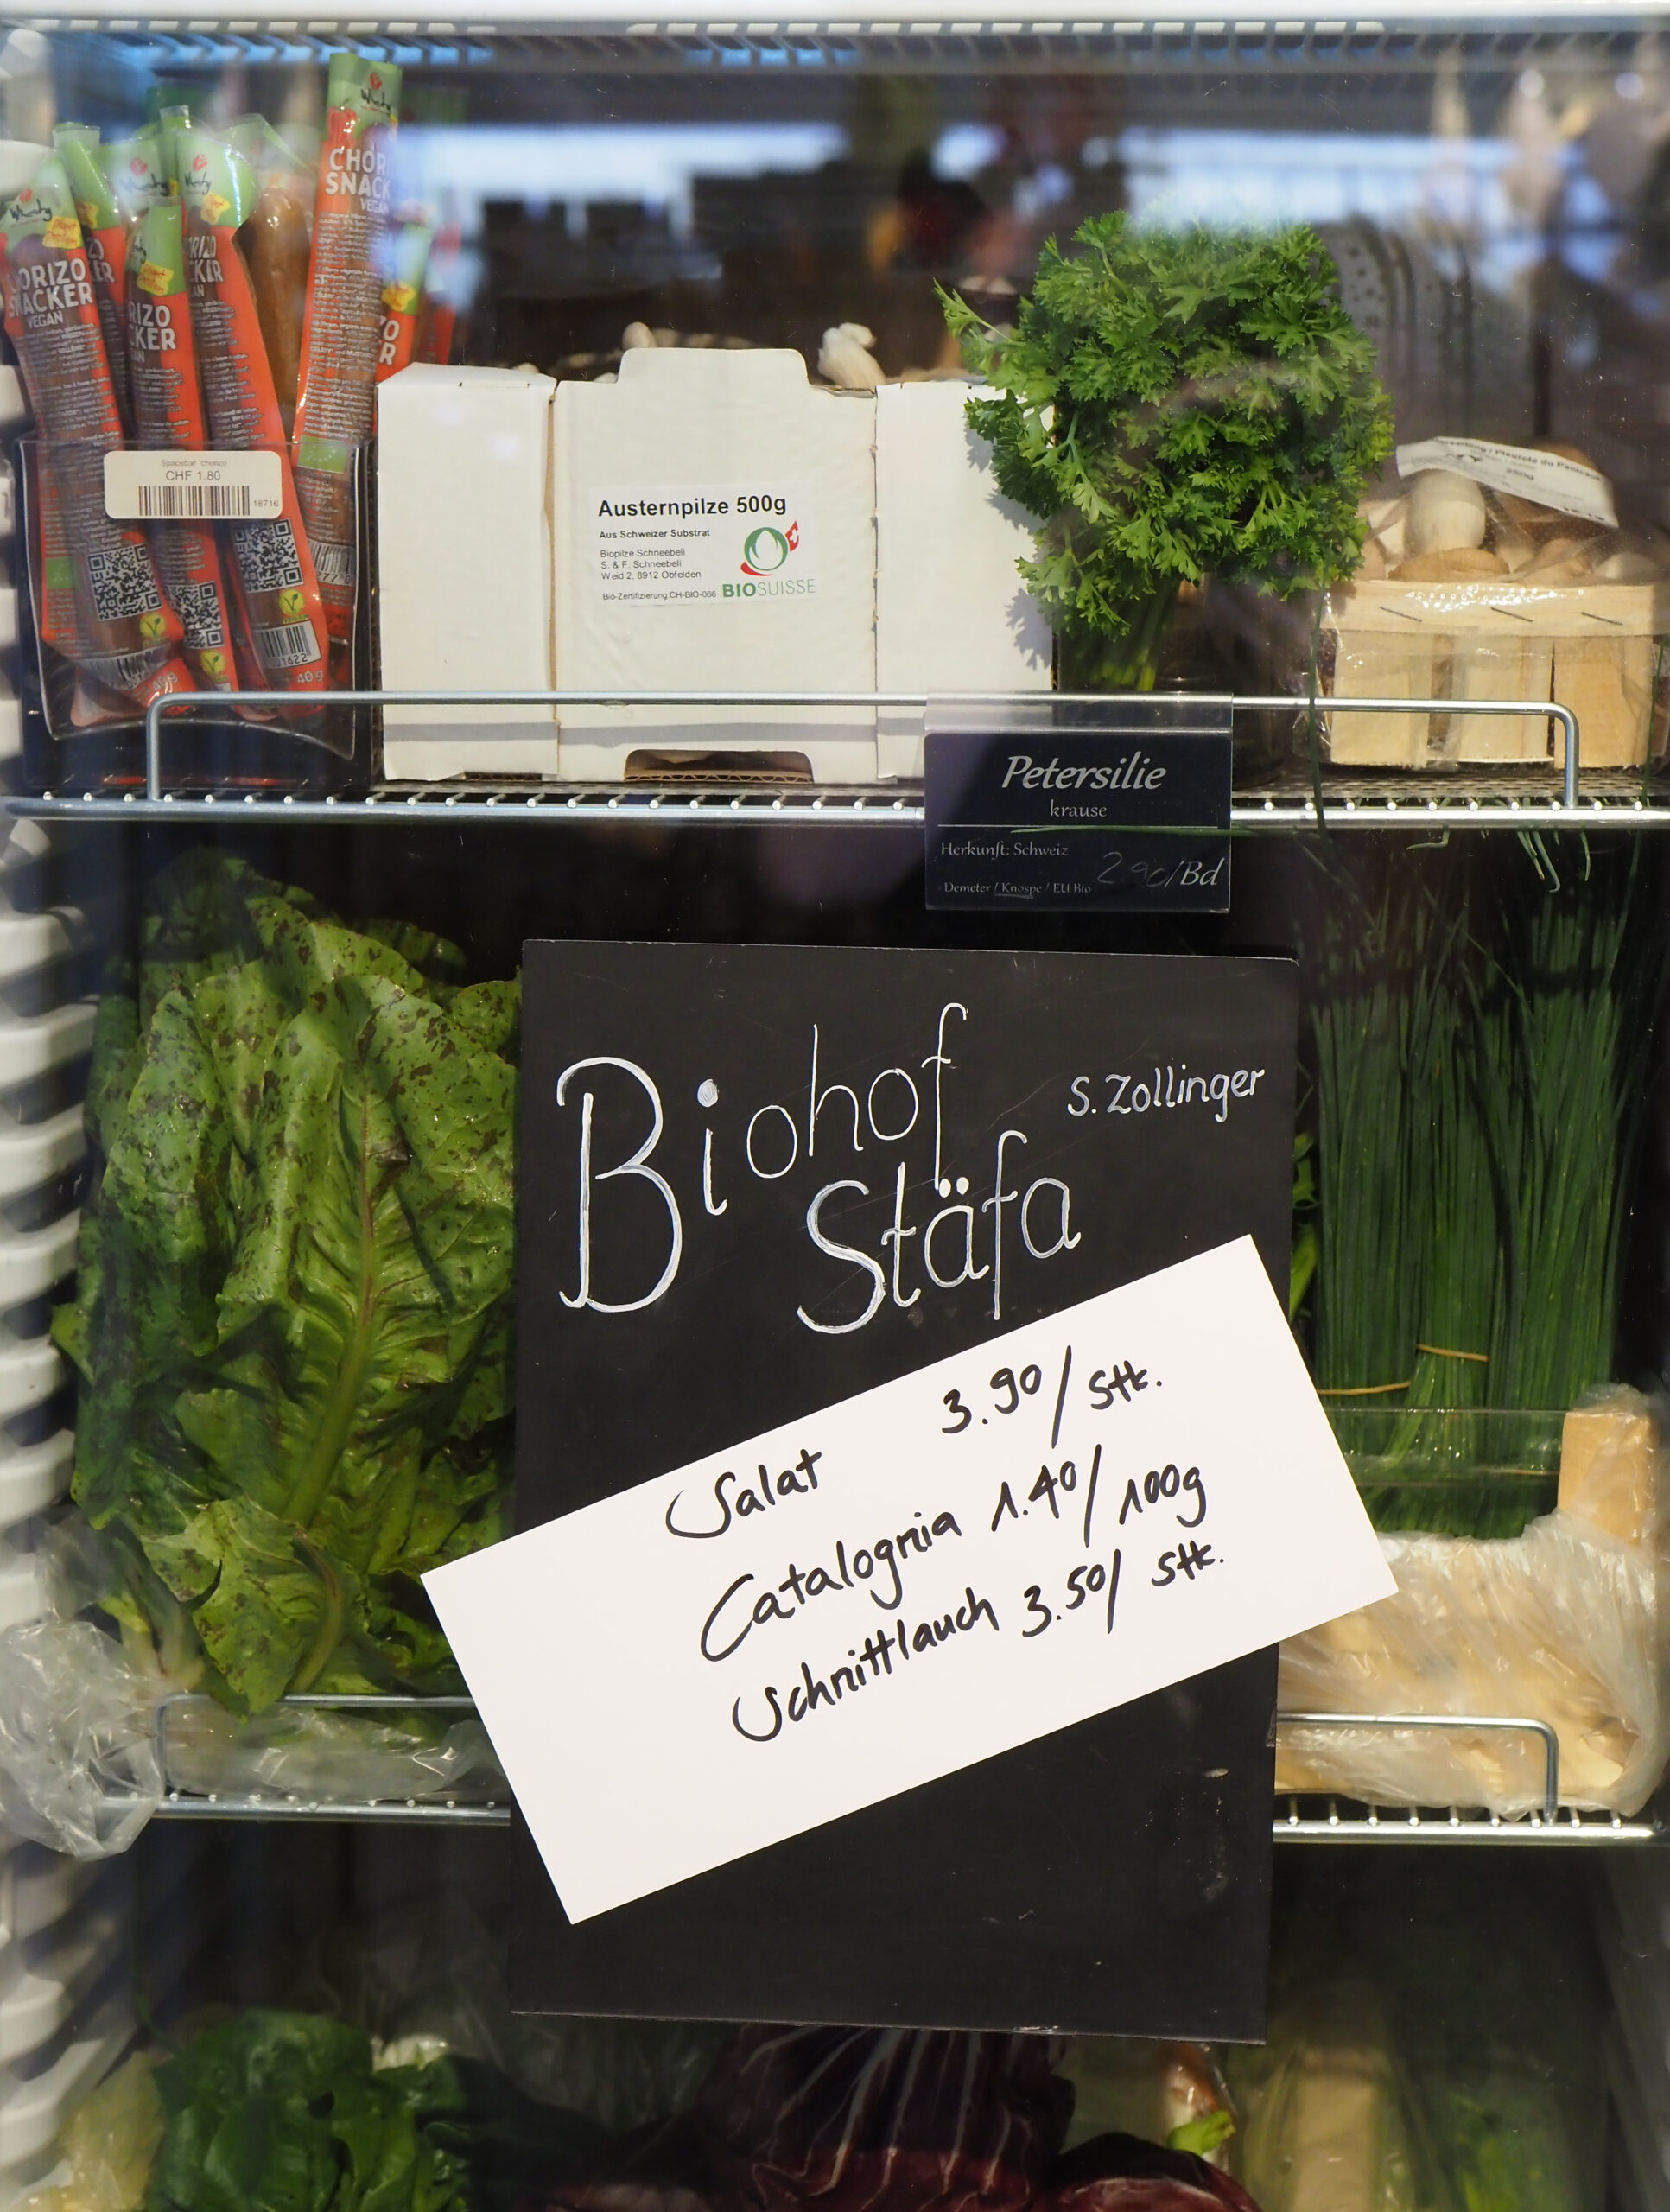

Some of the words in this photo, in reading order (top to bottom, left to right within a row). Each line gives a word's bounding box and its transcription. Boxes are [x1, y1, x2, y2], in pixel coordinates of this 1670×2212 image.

[329, 147, 389, 175] CHOR
[325, 171, 391, 201] SNACK
[166, 470, 192, 481] CHF
[198, 470, 221, 481] 1.80
[253, 499, 280, 508] 18716
[598, 498, 730, 518] Austernpilze
[736, 494, 787, 515] 500g
[600, 530, 618, 539] Aus
[619, 529, 668, 539] Schweizer
[670, 529, 711, 538] Substrat
[600, 550, 635, 559] Biopilze
[637, 548, 686, 557] Schneebeli
[632, 559, 682, 569] Schneebeli
[661, 570, 702, 579] Obfelden
[1001, 751, 1167, 790] Petersilie
[1051, 799, 1108, 818] krause
[941, 842, 1010, 861] Herkunft:
[1014, 842, 1069, 856] Schweiz
[944, 882, 992, 893] Demeter
[1001, 882, 1043, 896] Knospe
[1074, 882, 1092, 893] Bio
[1067, 1074, 1097, 1118] S.
[1108, 1065, 1266, 1122] Zollinger
[557, 1001, 968, 1313] Biohof
[797, 1129, 1082, 1334] Stäfa
[666, 1448, 822, 1539] Salat
[732, 1586, 1000, 1743] Schnittlauch
